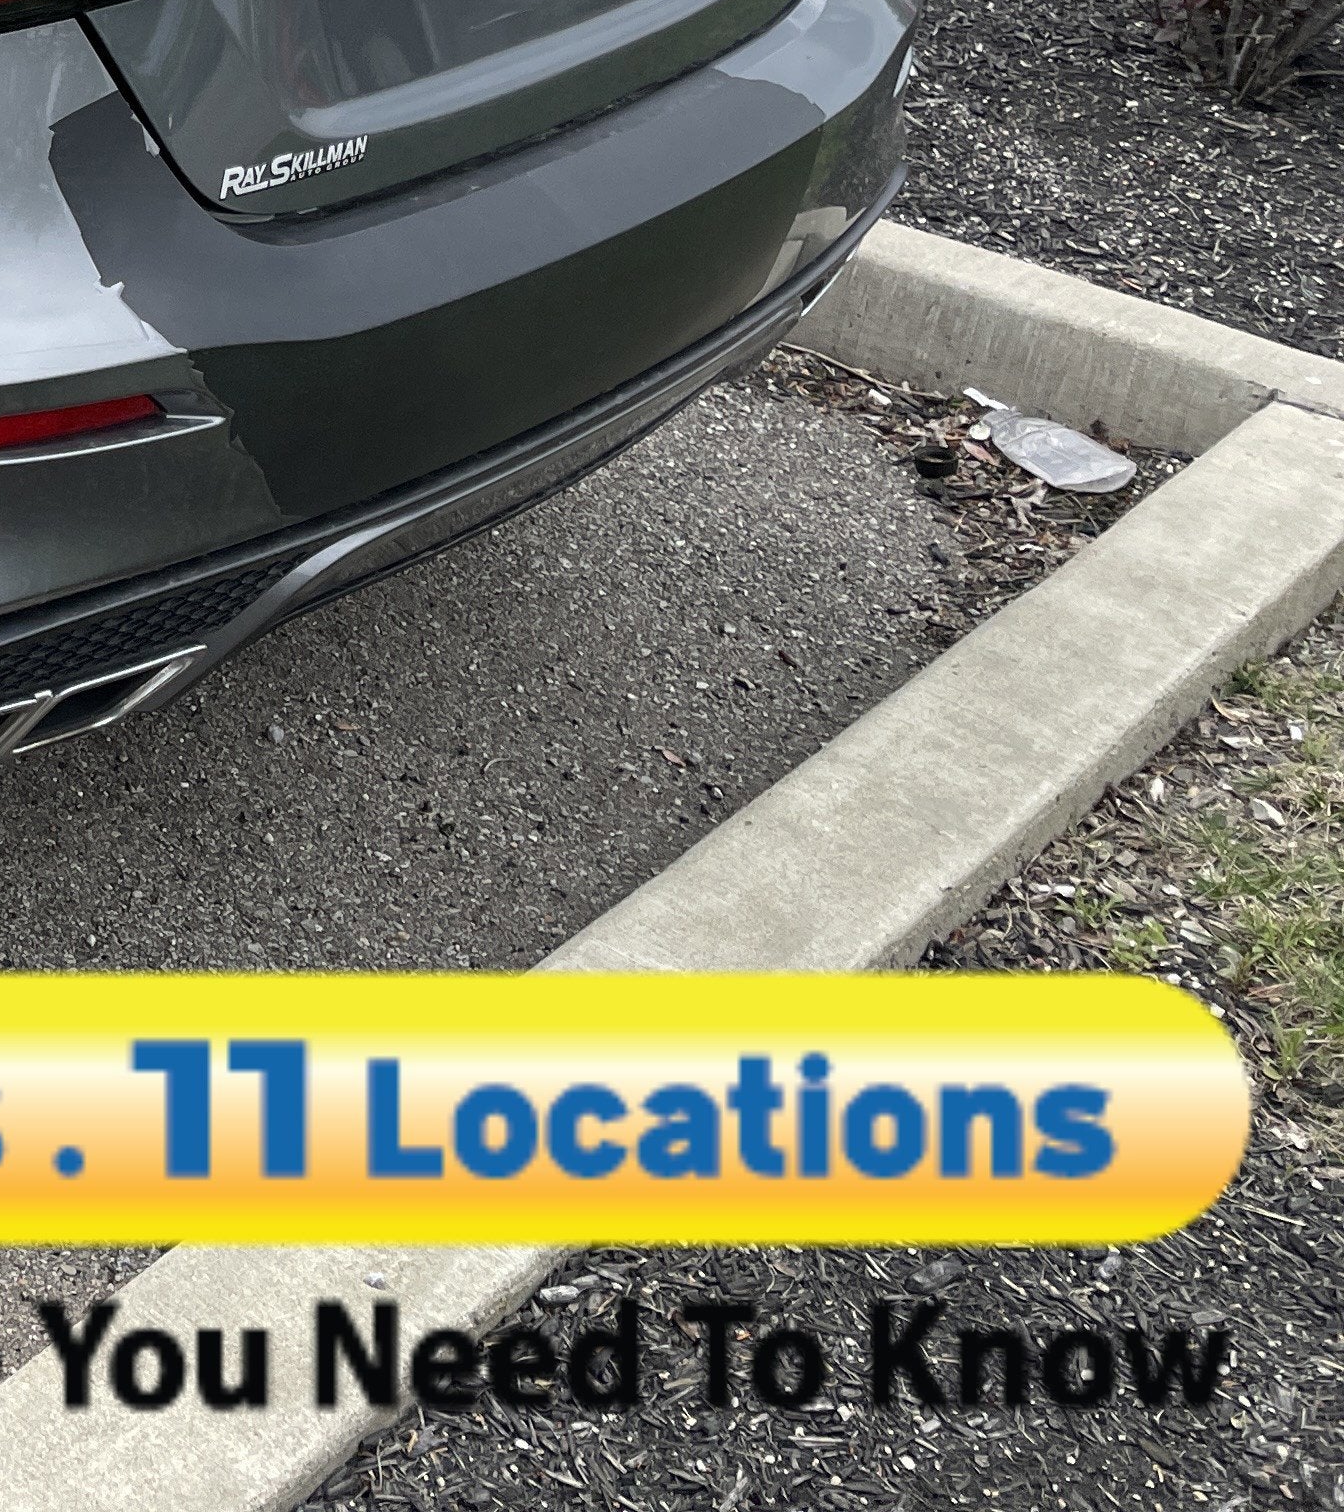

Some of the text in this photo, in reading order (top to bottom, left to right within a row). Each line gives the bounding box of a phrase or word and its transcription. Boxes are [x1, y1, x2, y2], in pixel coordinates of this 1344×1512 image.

[219, 134, 369, 200] RAY SKILLMAN
[290, 153, 365, 182] AUTO GROUP
